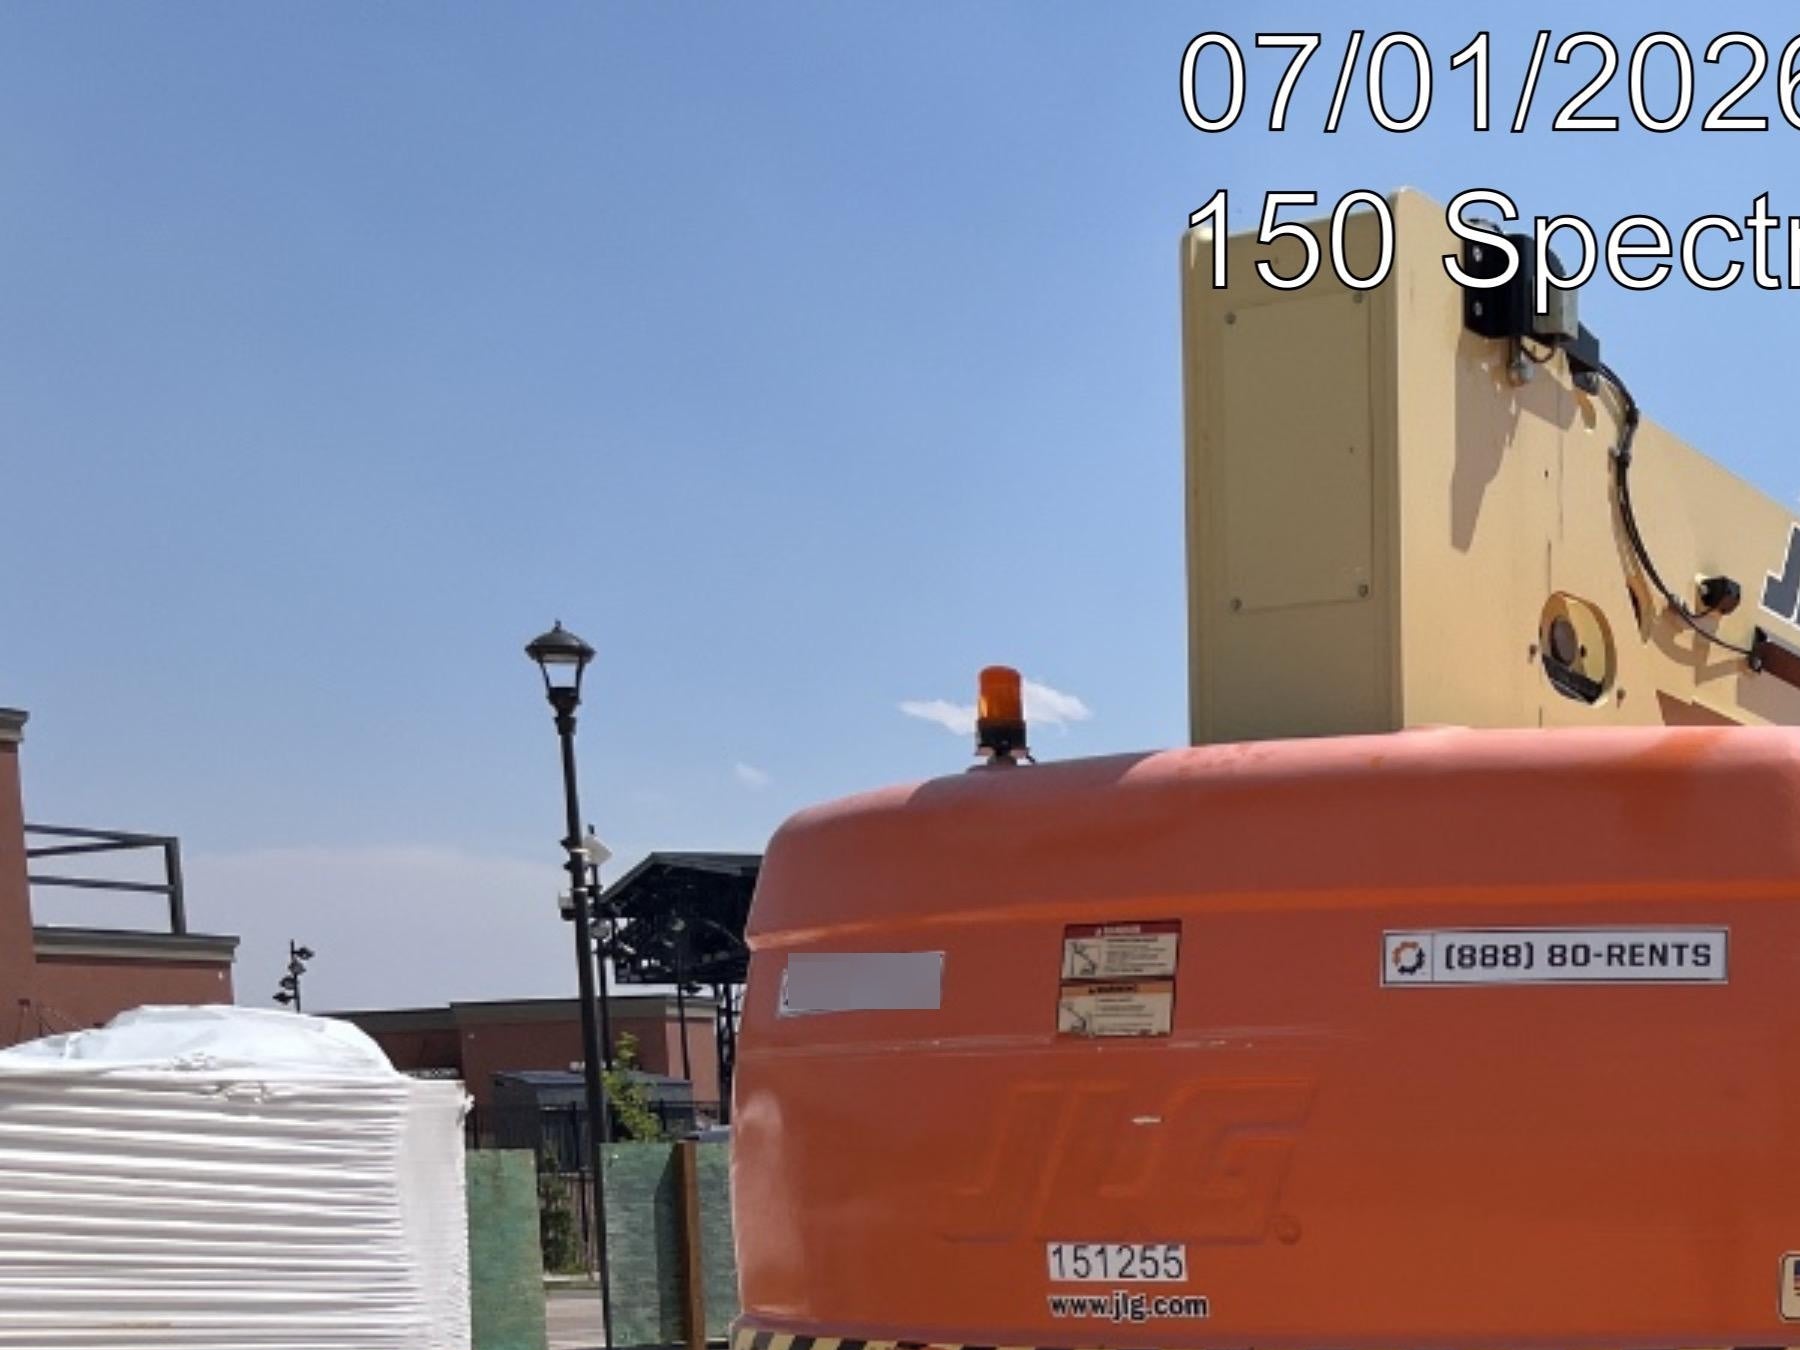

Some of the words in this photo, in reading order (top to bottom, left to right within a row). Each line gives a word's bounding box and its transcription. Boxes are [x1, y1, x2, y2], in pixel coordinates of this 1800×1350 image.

[1444, 941, 1535, 970] (888)
[1547, 943, 1712, 968] 80-RENTS
[1051, 1243, 1184, 1279] 151255
[1049, 1290, 1209, 1322] www.jlg.com
